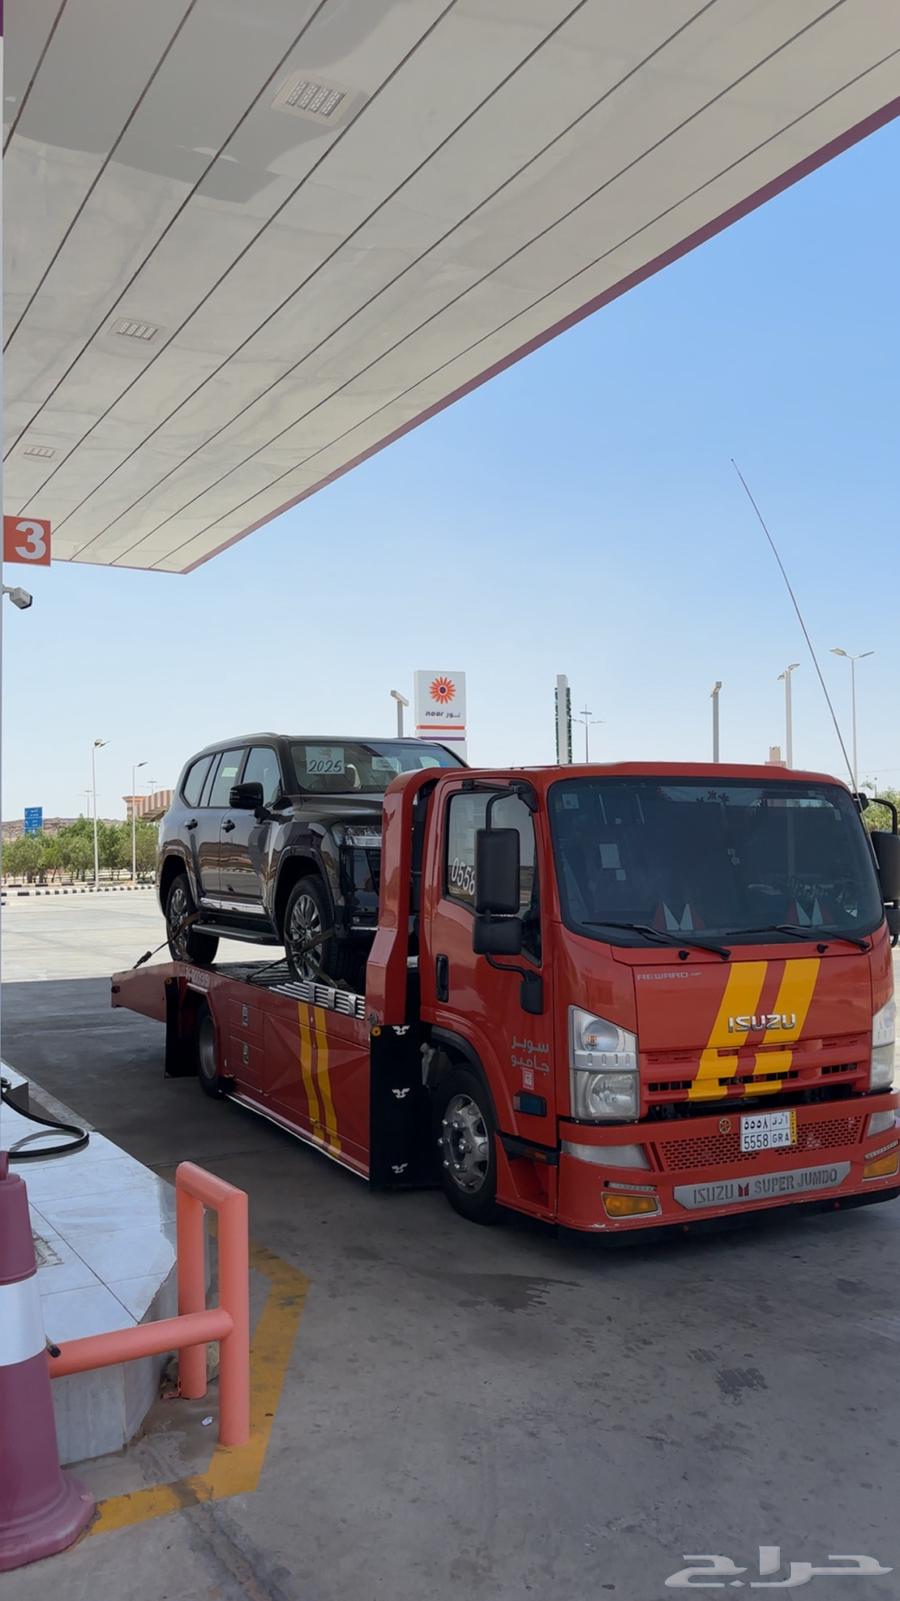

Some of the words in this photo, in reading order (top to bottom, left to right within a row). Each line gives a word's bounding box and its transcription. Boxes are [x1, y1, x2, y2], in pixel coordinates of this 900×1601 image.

[15, 521, 46, 560] 3
[308, 760, 342, 773] 2025
[728, 1014, 796, 1033] ISUZU
[744, 1133, 769, 1150] 5558
[693, 1184, 734, 1204] ISUZU
[754, 1175, 794, 1193] SUPER
